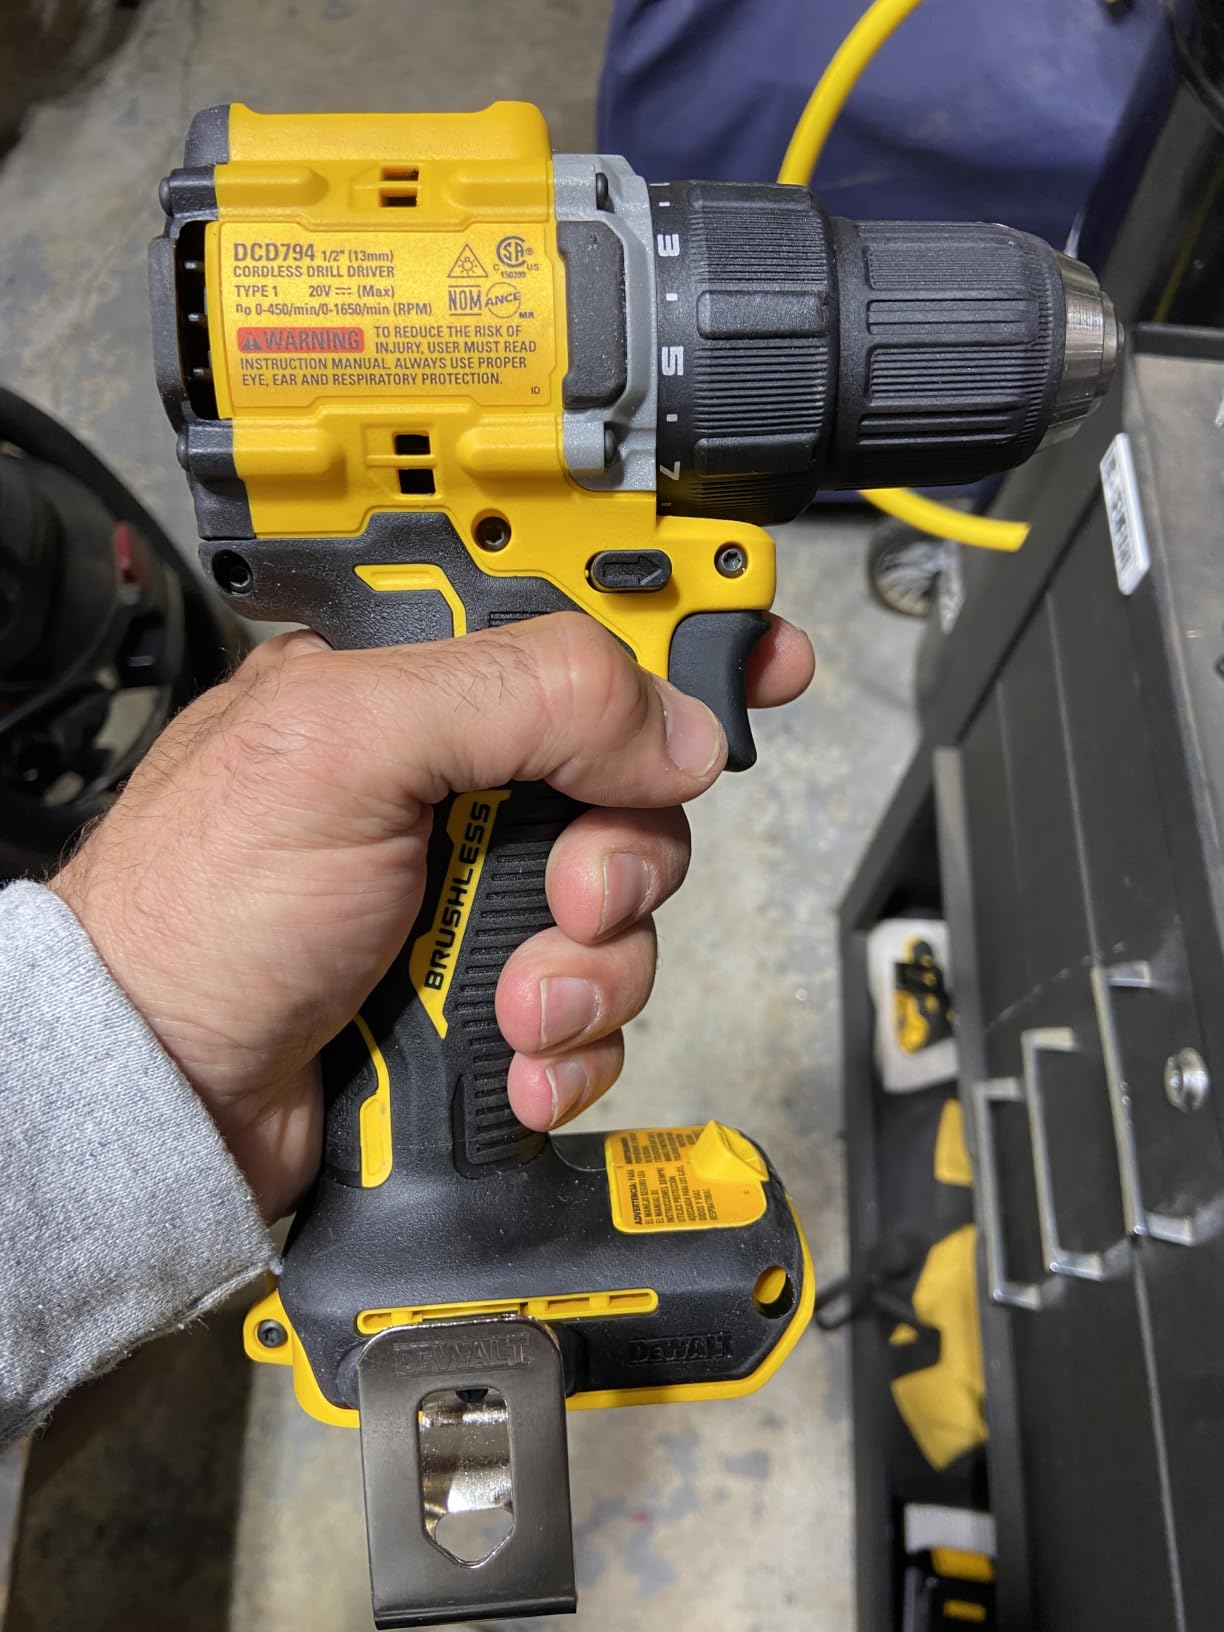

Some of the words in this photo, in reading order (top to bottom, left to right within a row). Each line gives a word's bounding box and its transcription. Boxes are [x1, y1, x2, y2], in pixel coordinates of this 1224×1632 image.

[657, 233, 680, 257] 3
[233, 243, 316, 262] DCD794
[322, 250, 345, 262] 1/2"
[348, 250, 394, 263] (13mm)
[233, 266, 303, 278] CORDLESS
[306, 266, 344, 278] DRILL
[347, 266, 395, 278] DRIVER
[234, 285, 268, 298] TYPE
[272, 285, 279, 298] 1
[308, 285, 332, 298] 20V
[357, 285, 396, 298] (Max)
[448, 289, 482, 312] NOM
[485, 292, 521, 308] ANCE
[255, 302, 390, 316] 0-450/min/0-1650/min
[393, 302, 433, 317] (RPM)
[374, 326, 392, 338] TO
[394, 326, 444, 338] REDUCE
[447, 325, 470, 338] THE
[474, 325, 504, 338] RISK
[506, 325, 522, 338] OF
[263, 330, 361, 352] WARNING
[375, 342, 425, 356] INJURY,
[428, 342, 460, 354] USER
[464, 342, 499, 353] MUST
[504, 342, 536, 353] READ
[240, 358, 328, 370] INSTRUCTION
[394, 357, 446, 370] ALWAYS
[450, 357, 474, 370] USE
[478, 356, 527, 370] PROPER
[661, 346, 684, 376] 5
[242, 374, 270, 388] EYE,
[272, 374, 298, 386] EAR
[302, 374, 329, 386] AND
[332, 374, 418, 386] RESPIRATORY
[422, 373, 504, 386] PROTECTION.
[424, 801, 491, 990] BRUSHLESS
